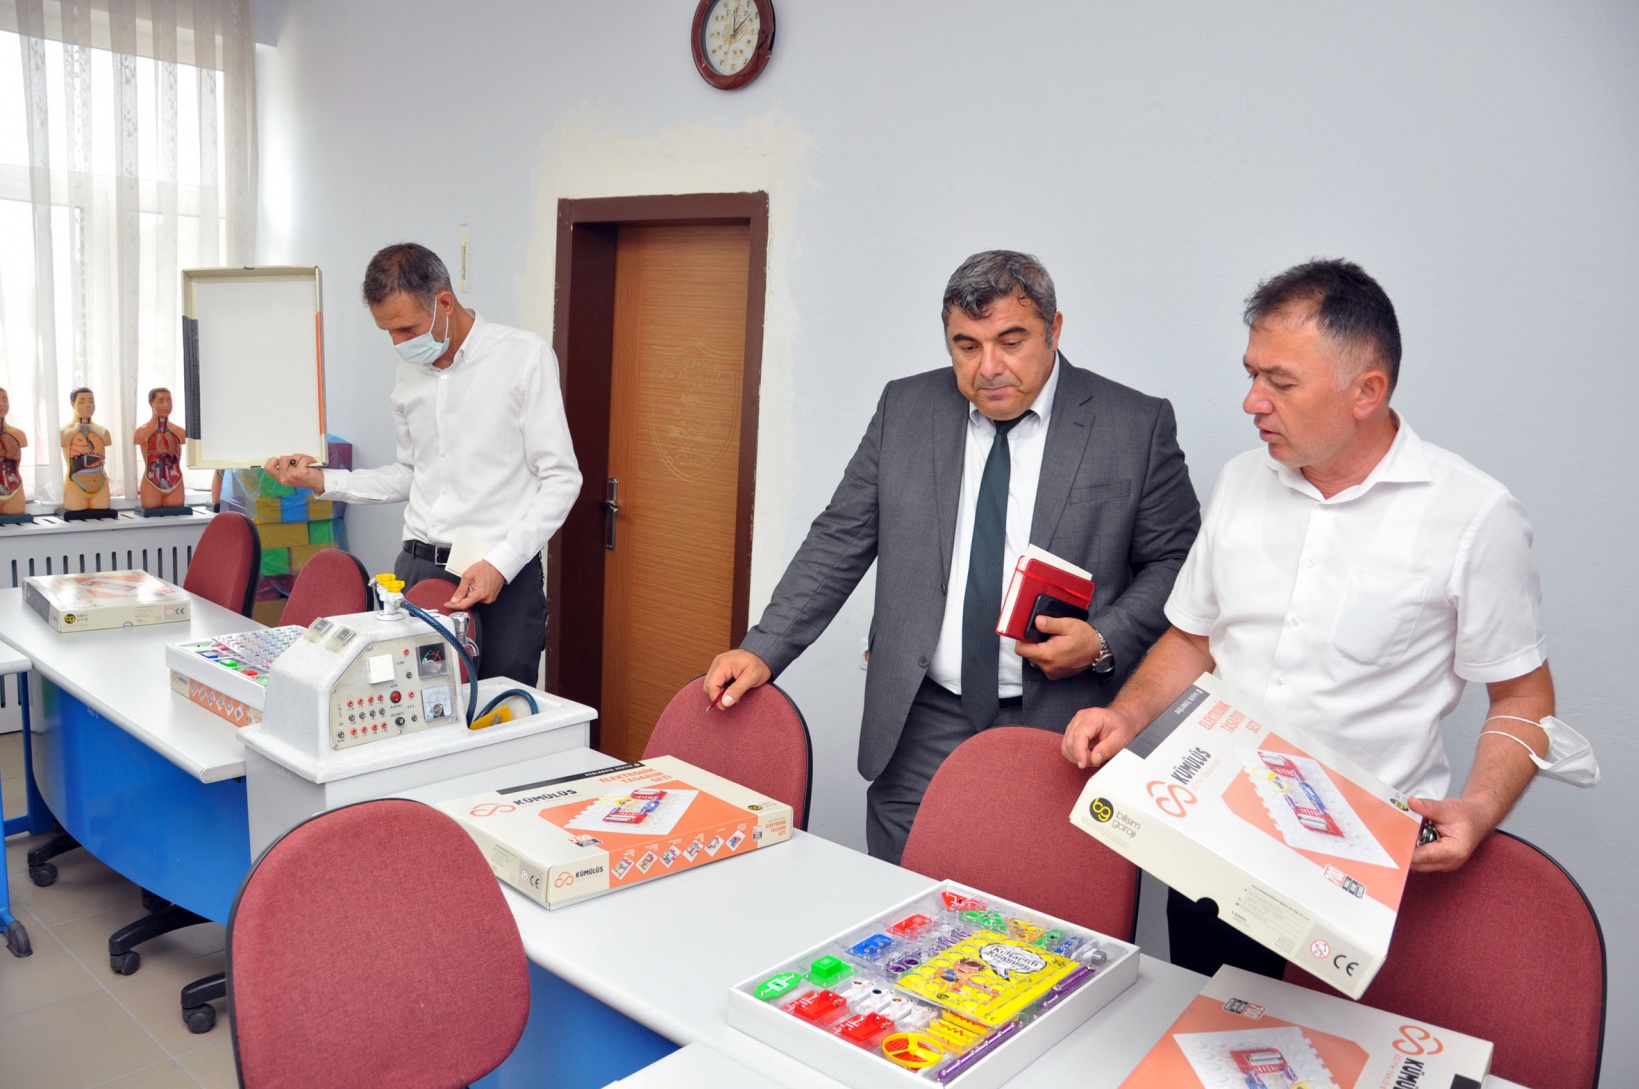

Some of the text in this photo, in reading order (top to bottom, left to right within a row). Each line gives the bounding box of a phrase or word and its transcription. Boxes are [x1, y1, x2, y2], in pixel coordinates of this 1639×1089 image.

[1220, 709, 1247, 733] TASARIM
[1171, 747, 1211, 785] KÜMÜLÜS
[622, 771, 665, 784] TASARIM
[513, 788, 578, 806] KÜMÜLÜS
[575, 866, 604, 879] KÜMÜLÜS
[1333, 954, 1360, 977] CE
